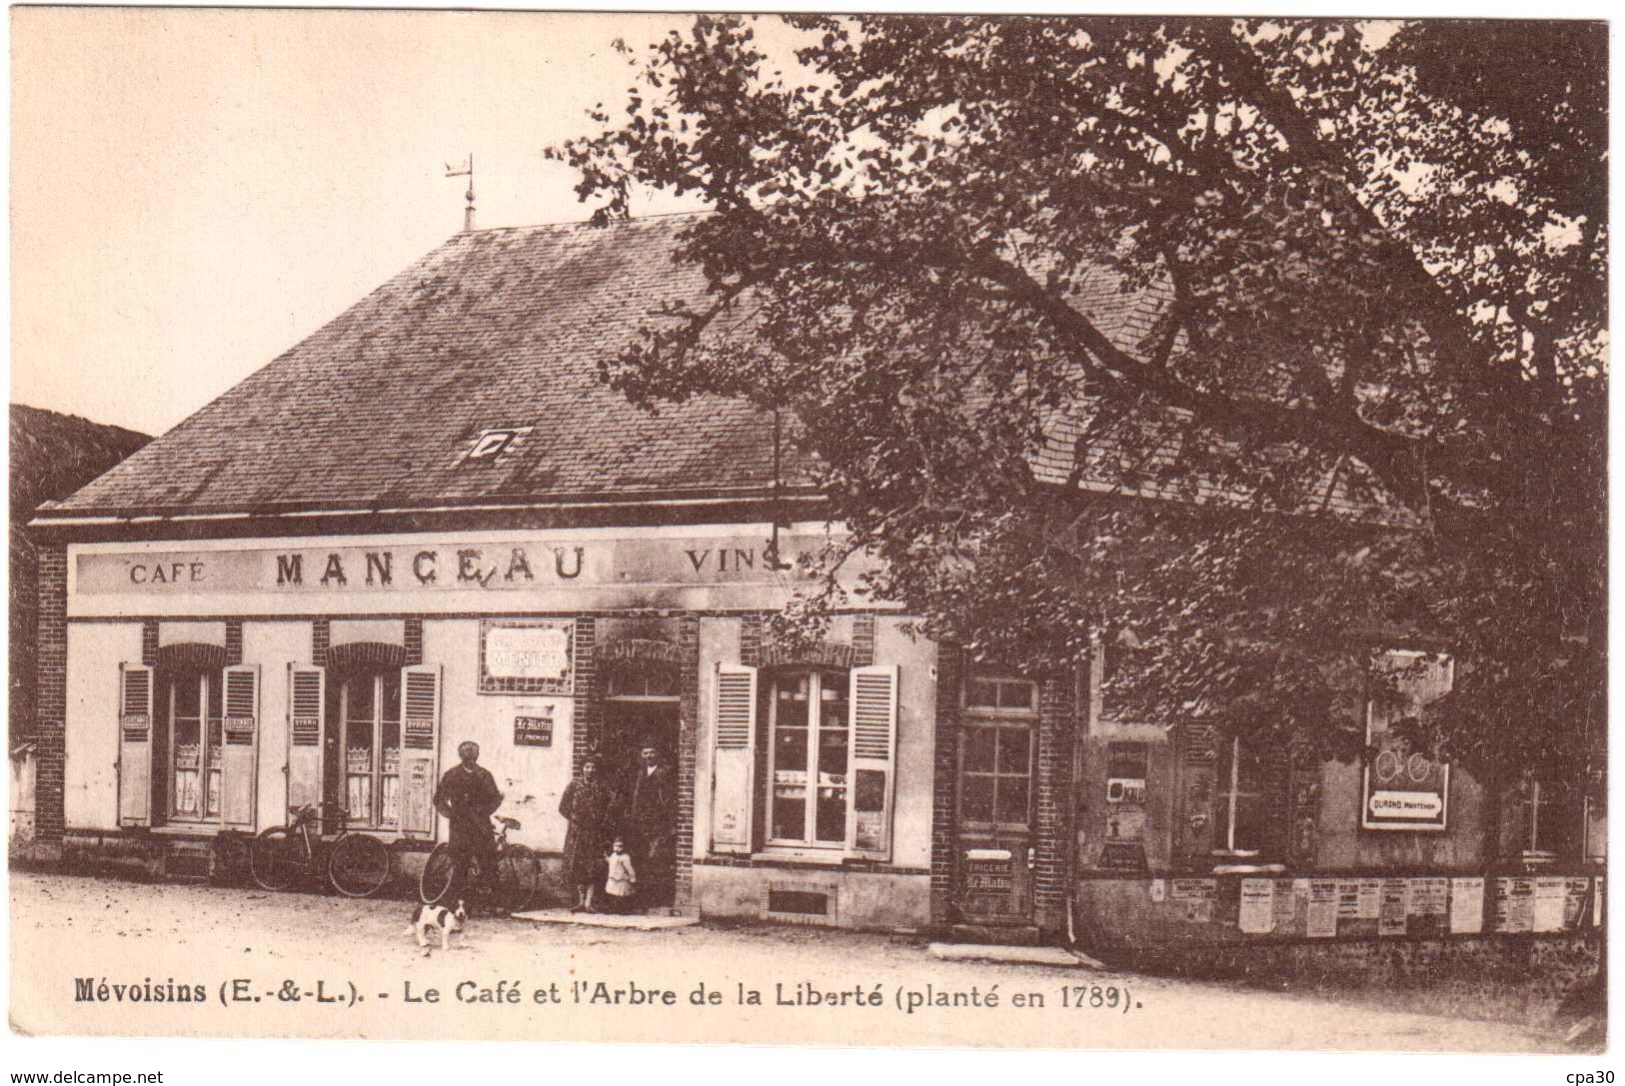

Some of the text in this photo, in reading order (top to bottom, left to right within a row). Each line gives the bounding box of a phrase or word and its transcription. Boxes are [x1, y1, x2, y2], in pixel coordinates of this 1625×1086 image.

[129, 546, 780, 588] CAFÉ MANCEAU VINS
[492, 651, 562, 667] MENIER
